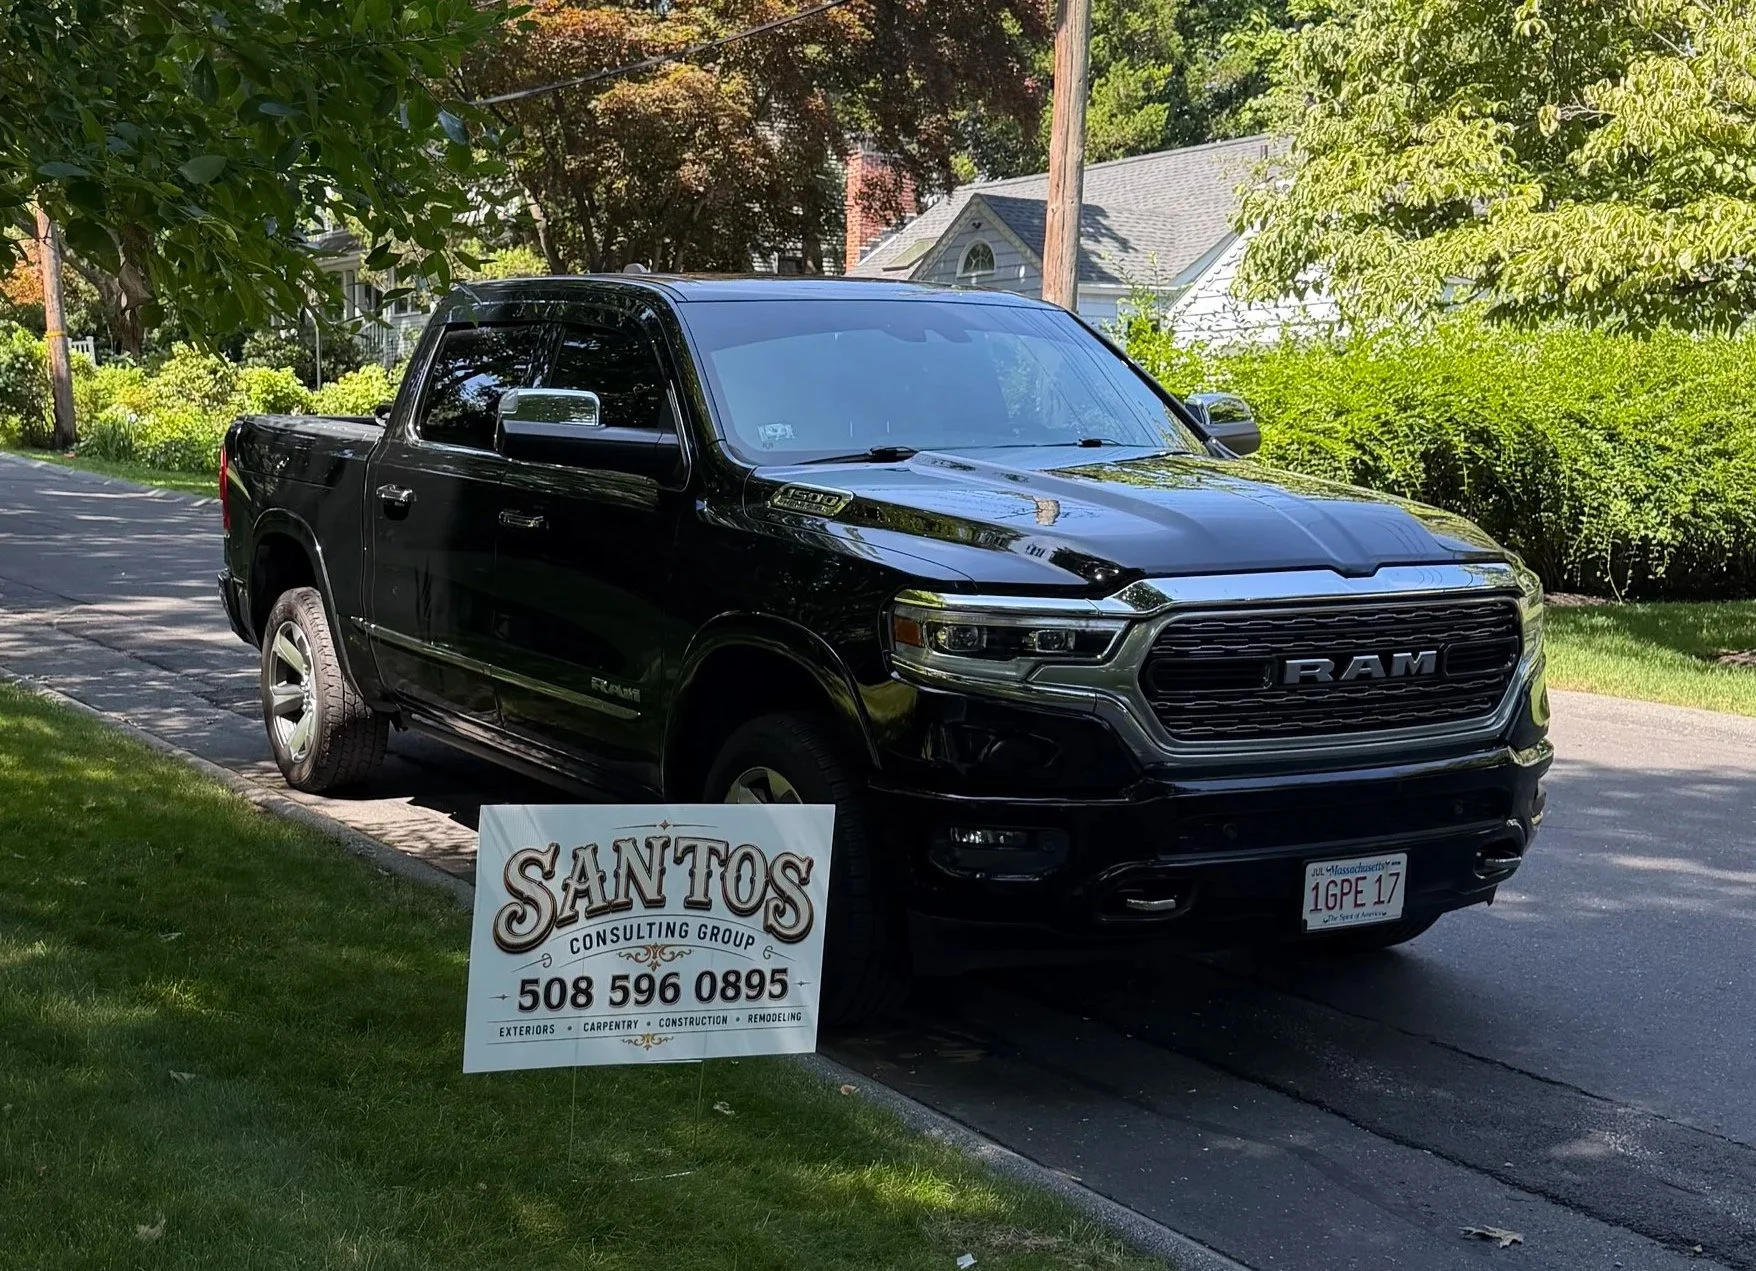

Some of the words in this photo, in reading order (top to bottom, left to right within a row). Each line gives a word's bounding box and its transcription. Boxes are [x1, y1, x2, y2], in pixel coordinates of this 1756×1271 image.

[787, 488, 839, 506] 1500
[1283, 650, 1437, 684] RAM
[1311, 867, 1325, 877] JUL
[1330, 862, 1385, 876] Massachusetts
[493, 835, 814, 953] SANTOS
[1309, 876, 1367, 913] 1GPE
[1373, 872, 1401, 906] 17
[570, 921, 690, 955] CONSULTING
[697, 923, 756, 950] GROUP
[518, 975, 594, 1013] 508
[609, 972, 681, 1008] 596
[694, 967, 789, 1003] 0895
[499, 1023, 555, 1038] EXTERIORS
[583, 1019, 639, 1033] CARPENTRY
[658, 1015, 728, 1028] CONSTRUCTION
[747, 1011, 802, 1024] REMODELING
